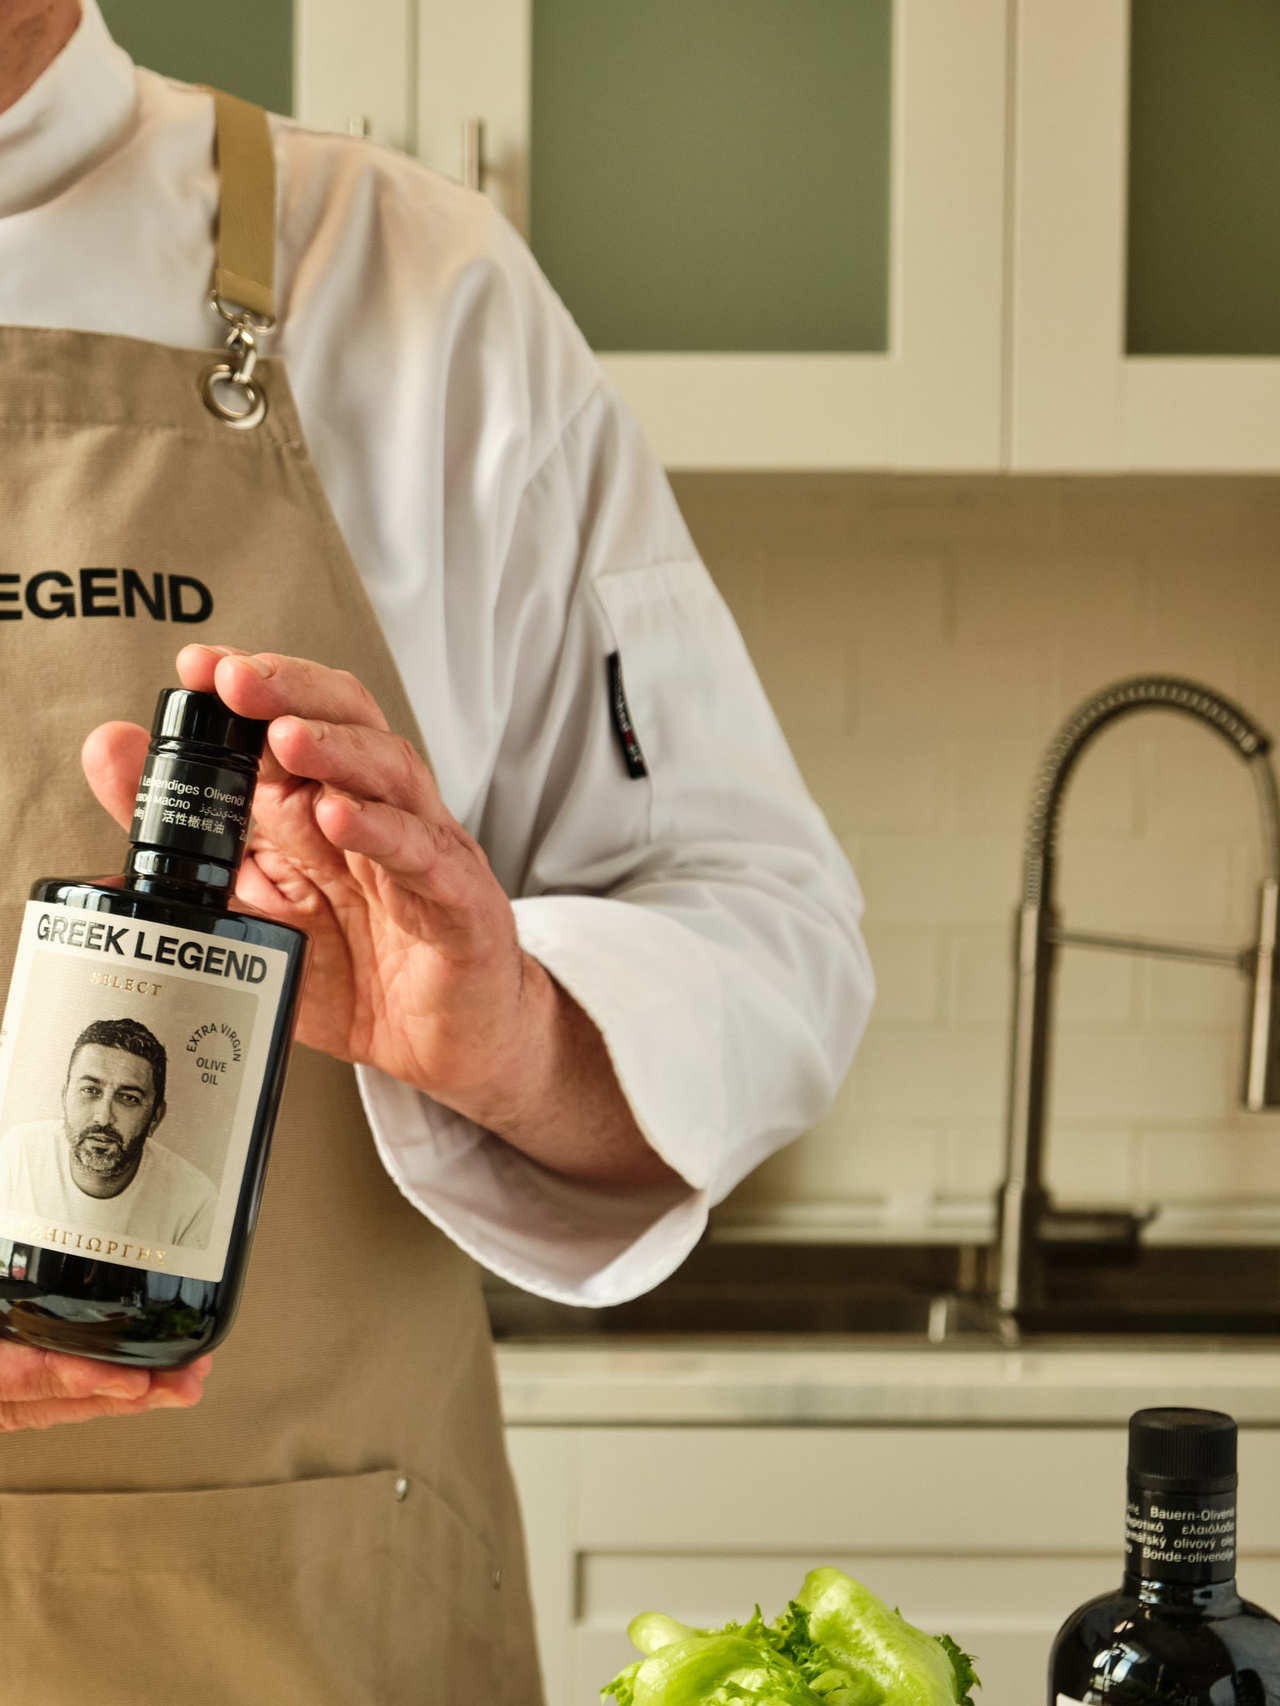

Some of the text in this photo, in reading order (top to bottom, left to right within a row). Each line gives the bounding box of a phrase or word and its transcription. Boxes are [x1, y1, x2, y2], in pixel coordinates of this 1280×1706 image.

[142, 775, 200, 795] Lebendiges
[204, 787, 245, 807] Olivenöl
[37, 914, 267, 984] GREEK LEGEND
[91, 972, 162, 996] SELECT
[186, 1022, 242, 1062] EXTRA VIRGIN
[196, 1057, 227, 1073] OLIVE
[201, 1072, 218, 1086] OIL
